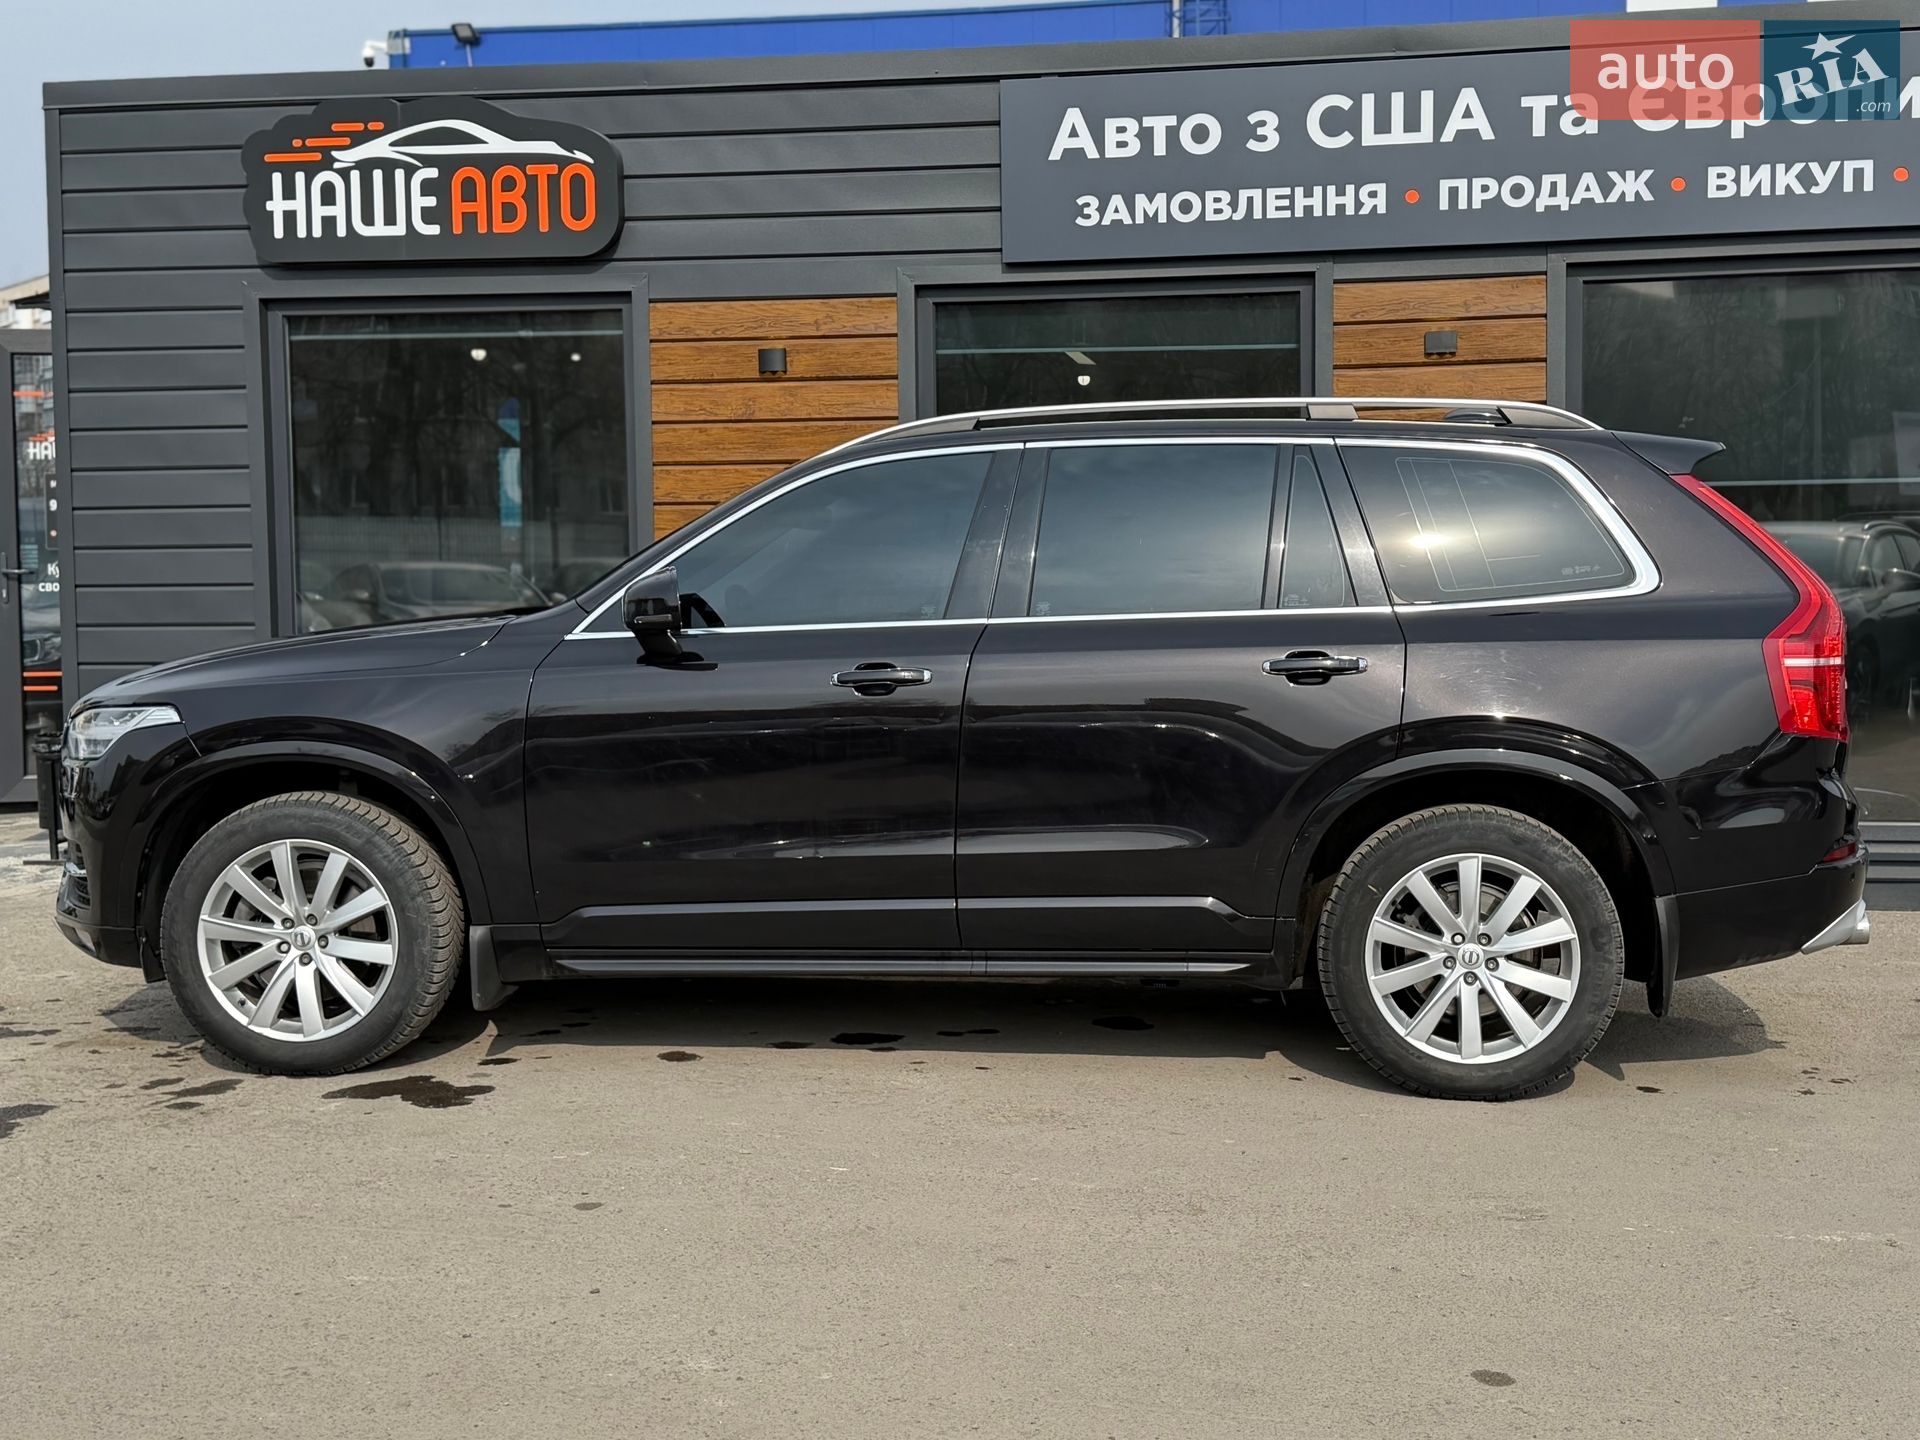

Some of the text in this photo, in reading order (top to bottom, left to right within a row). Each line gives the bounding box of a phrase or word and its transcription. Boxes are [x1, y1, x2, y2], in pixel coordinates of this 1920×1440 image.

[1047, 106, 1223, 161] Авто
[1306, 87, 1495, 149] США
[1520, 91, 1599, 138] та
[265, 162, 596, 239] НАШЕ АВТО
[1074, 159, 1874, 227] ЗАМОВЛЕННЯ ПРОДАЖ ВИКУП
[27, 441, 56, 460] НА
